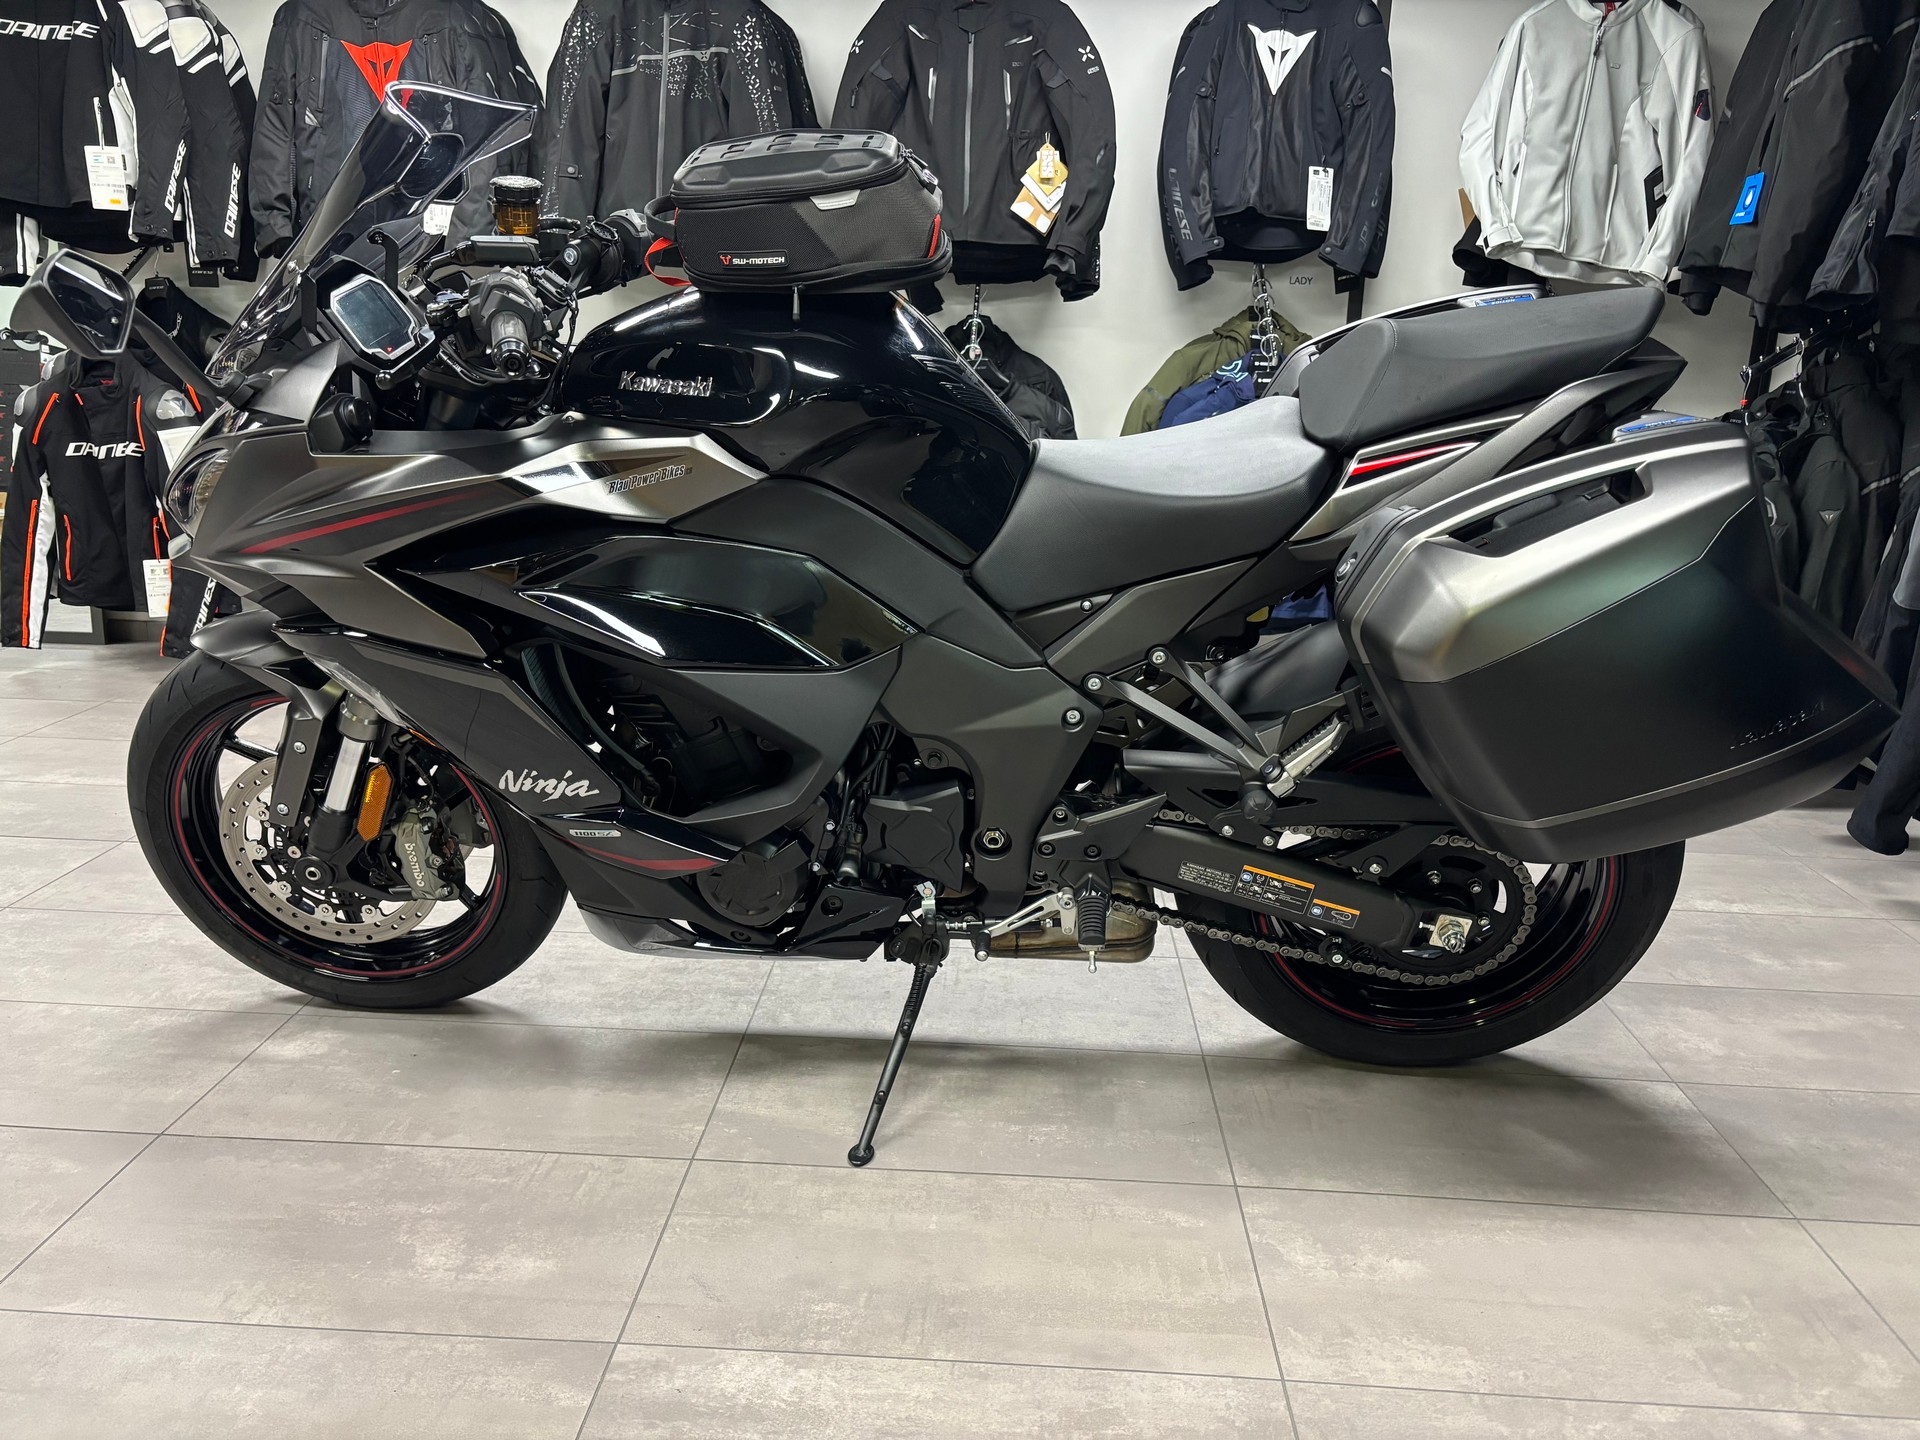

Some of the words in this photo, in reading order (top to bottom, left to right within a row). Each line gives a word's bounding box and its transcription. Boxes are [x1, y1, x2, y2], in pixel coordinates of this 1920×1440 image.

[164, 139, 187, 213] DAINESE
[224, 162, 242, 238] DAINESE
[732, 256, 785, 265] SW-MOTECH
[1289, 276, 1313, 285] LADY
[618, 370, 713, 397] Kawasaki
[608, 479, 629, 494] Blau
[630, 472, 660, 489] Power
[498, 768, 600, 802] Ninja
[404, 842, 425, 887] brembo
